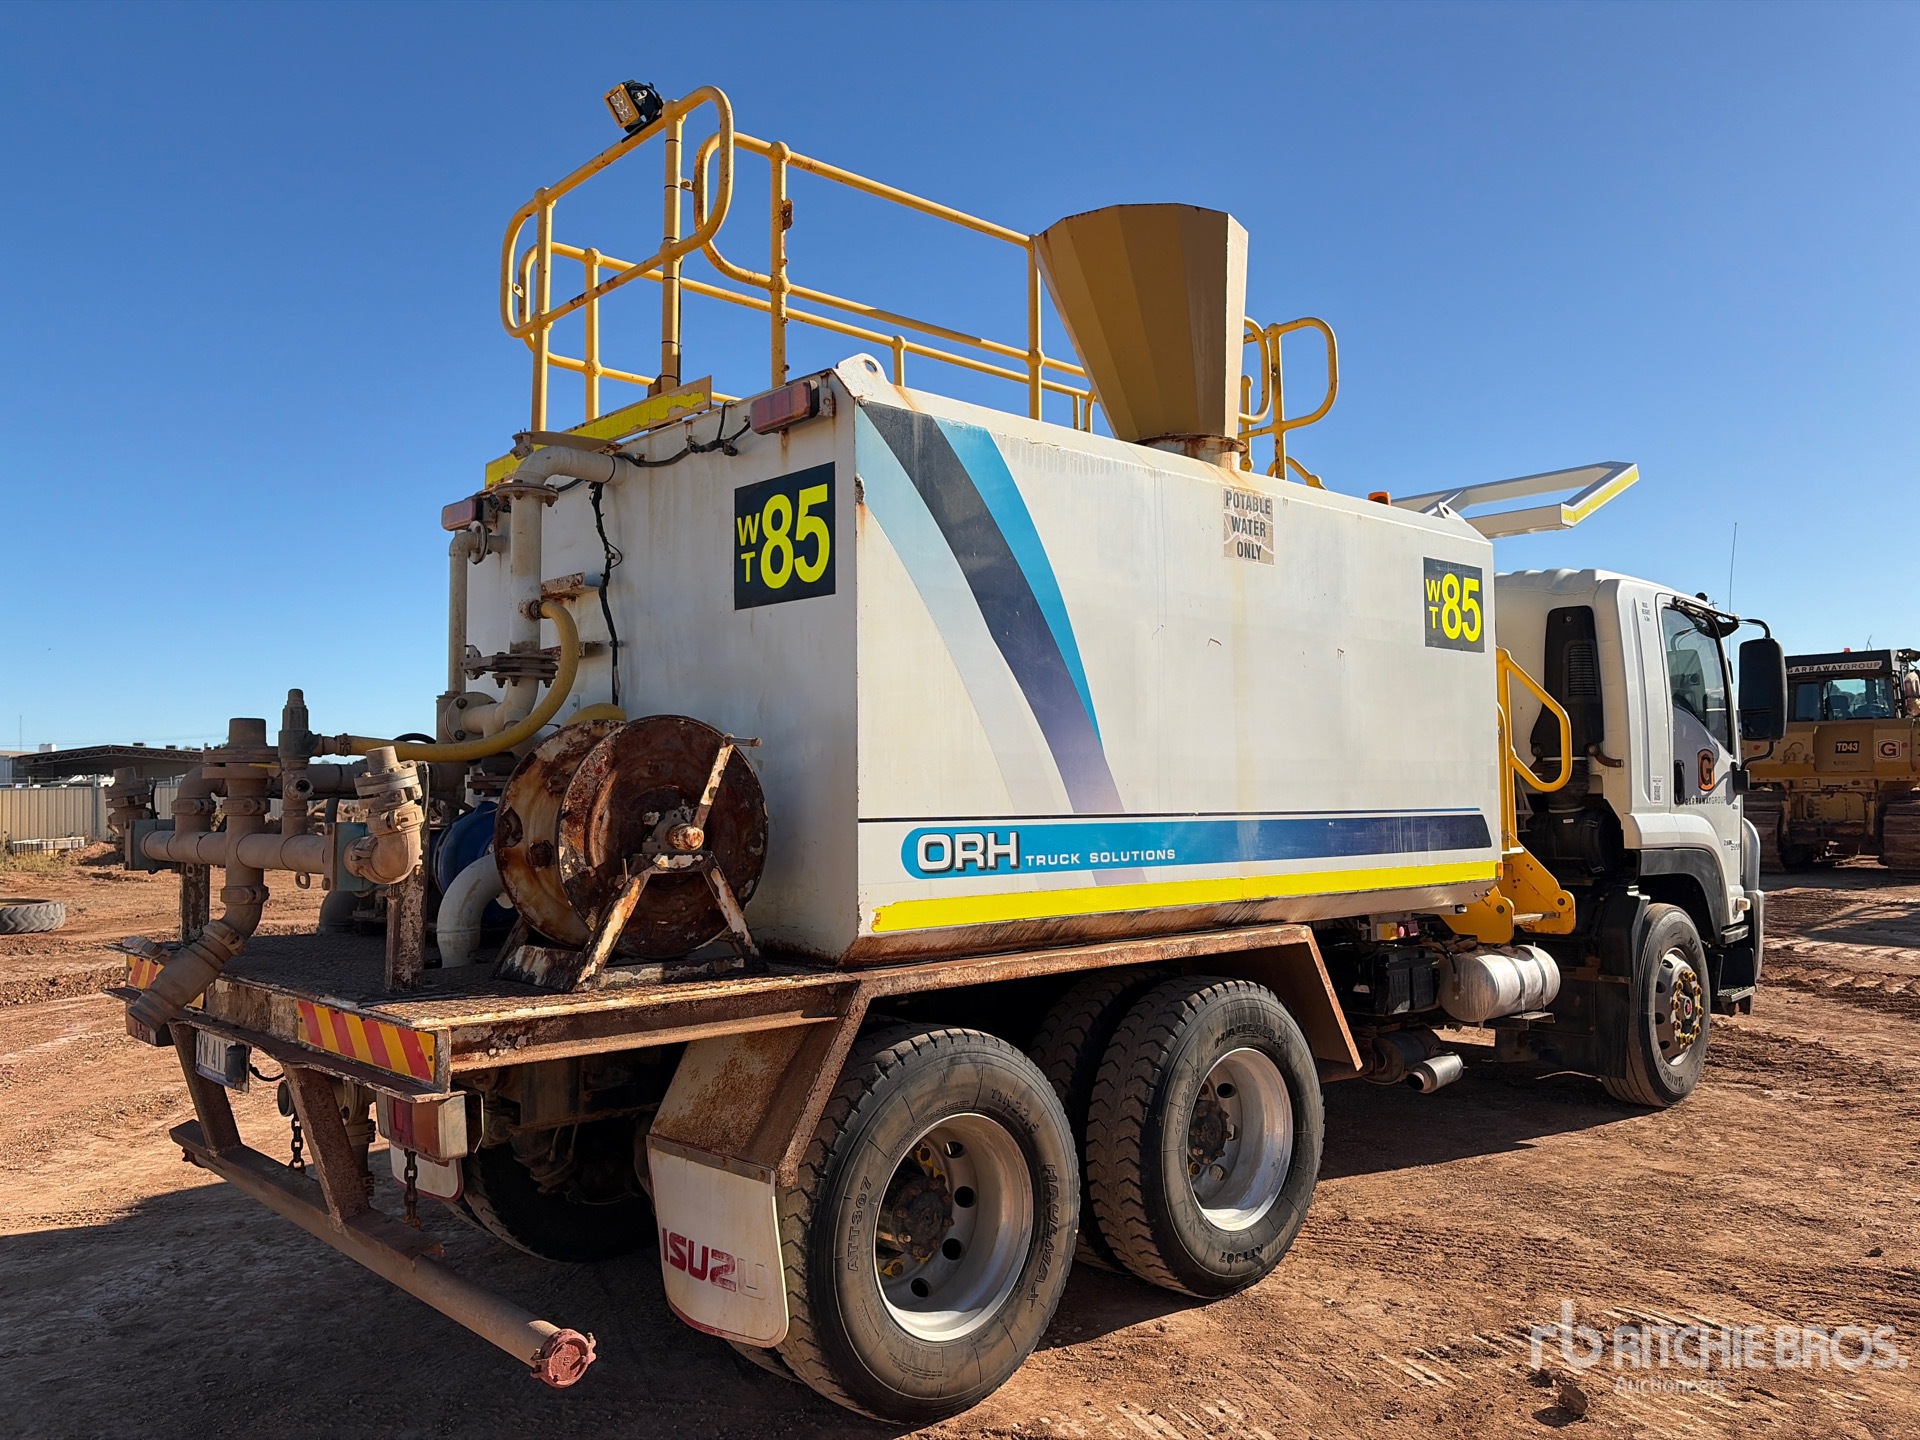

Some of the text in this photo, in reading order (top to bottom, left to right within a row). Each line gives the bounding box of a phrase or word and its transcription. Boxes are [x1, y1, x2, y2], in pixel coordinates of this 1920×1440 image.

[1225, 490, 1271, 515] POTABLE
[737, 483, 831, 589] W 85
[1231, 515, 1267, 538] WATER
[1236, 540, 1262, 560] ONLY
[741, 551, 755, 583] T
[1425, 572, 1482, 642] W 85
[1428, 606, 1438, 629] T
[1836, 742, 1859, 753] TD43
[1880, 742, 1897, 757] G
[916, 831, 1176, 873] ORH TRUCK SOLUTIONS
[847, 1175, 872, 1272] ATT307
[1026, 1163, 1060, 1309] HAULMAX
